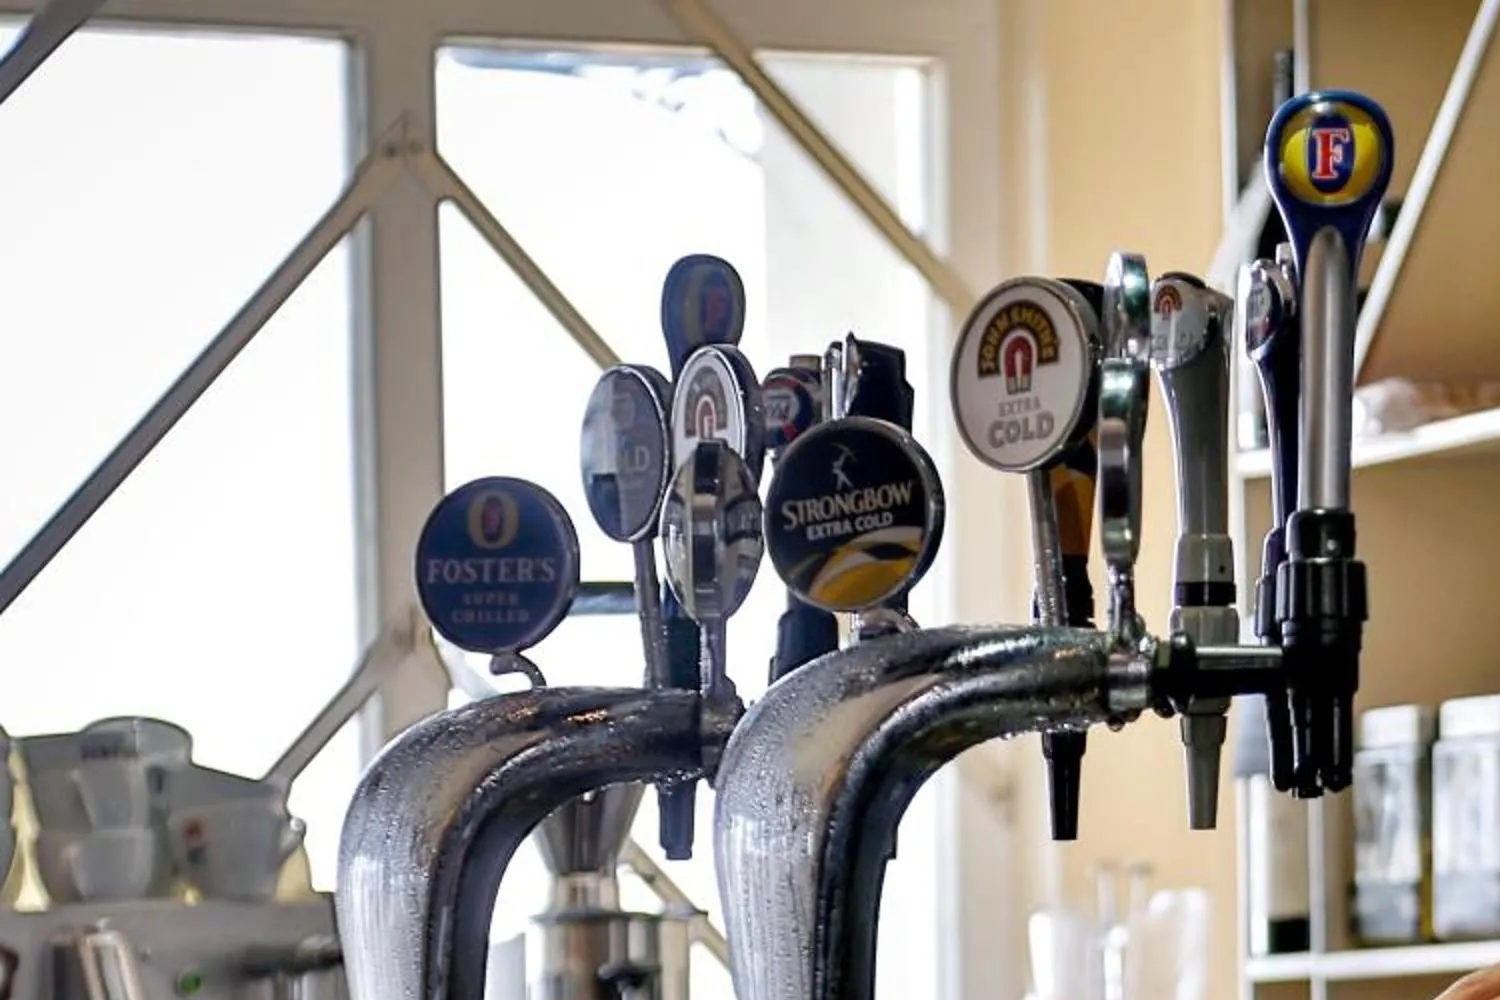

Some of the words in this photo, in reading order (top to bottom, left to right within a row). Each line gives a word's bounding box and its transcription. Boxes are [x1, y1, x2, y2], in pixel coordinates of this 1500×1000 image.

[1310, 128, 1350, 180] F
[998, 396, 1041, 418] EXTRA
[988, 410, 1055, 449] COLD
[781, 479, 913, 531] STRONGBOW
[806, 520, 851, 542] EXTRA
[854, 511, 894, 532] COLD
[426, 556, 557, 584] FOSTER'S
